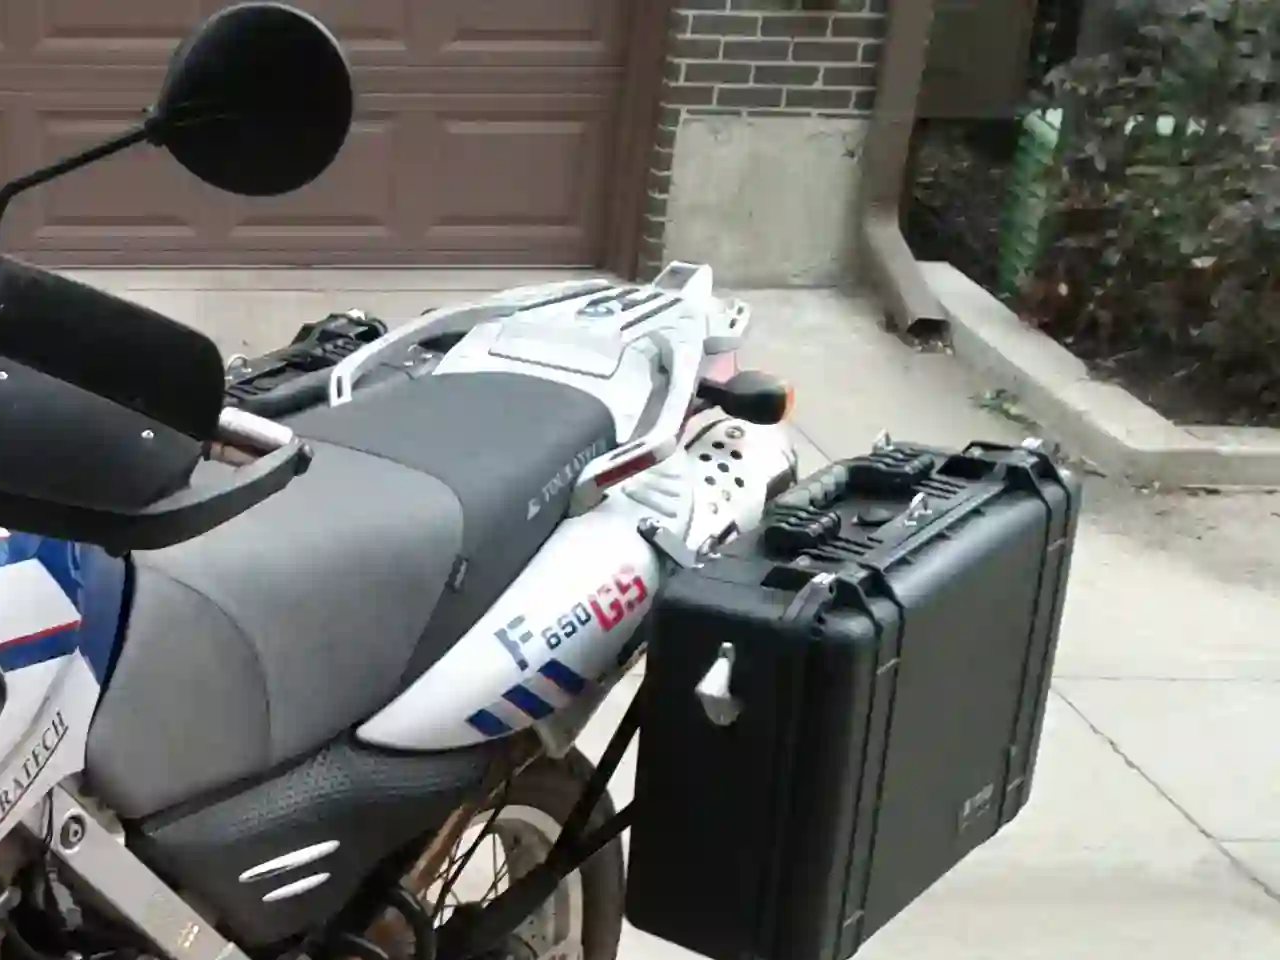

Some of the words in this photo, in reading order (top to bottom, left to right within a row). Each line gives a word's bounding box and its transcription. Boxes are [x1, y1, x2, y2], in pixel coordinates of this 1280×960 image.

[494, 614, 533, 671] F
[541, 601, 592, 650] 650
[587, 563, 648, 632] GS
